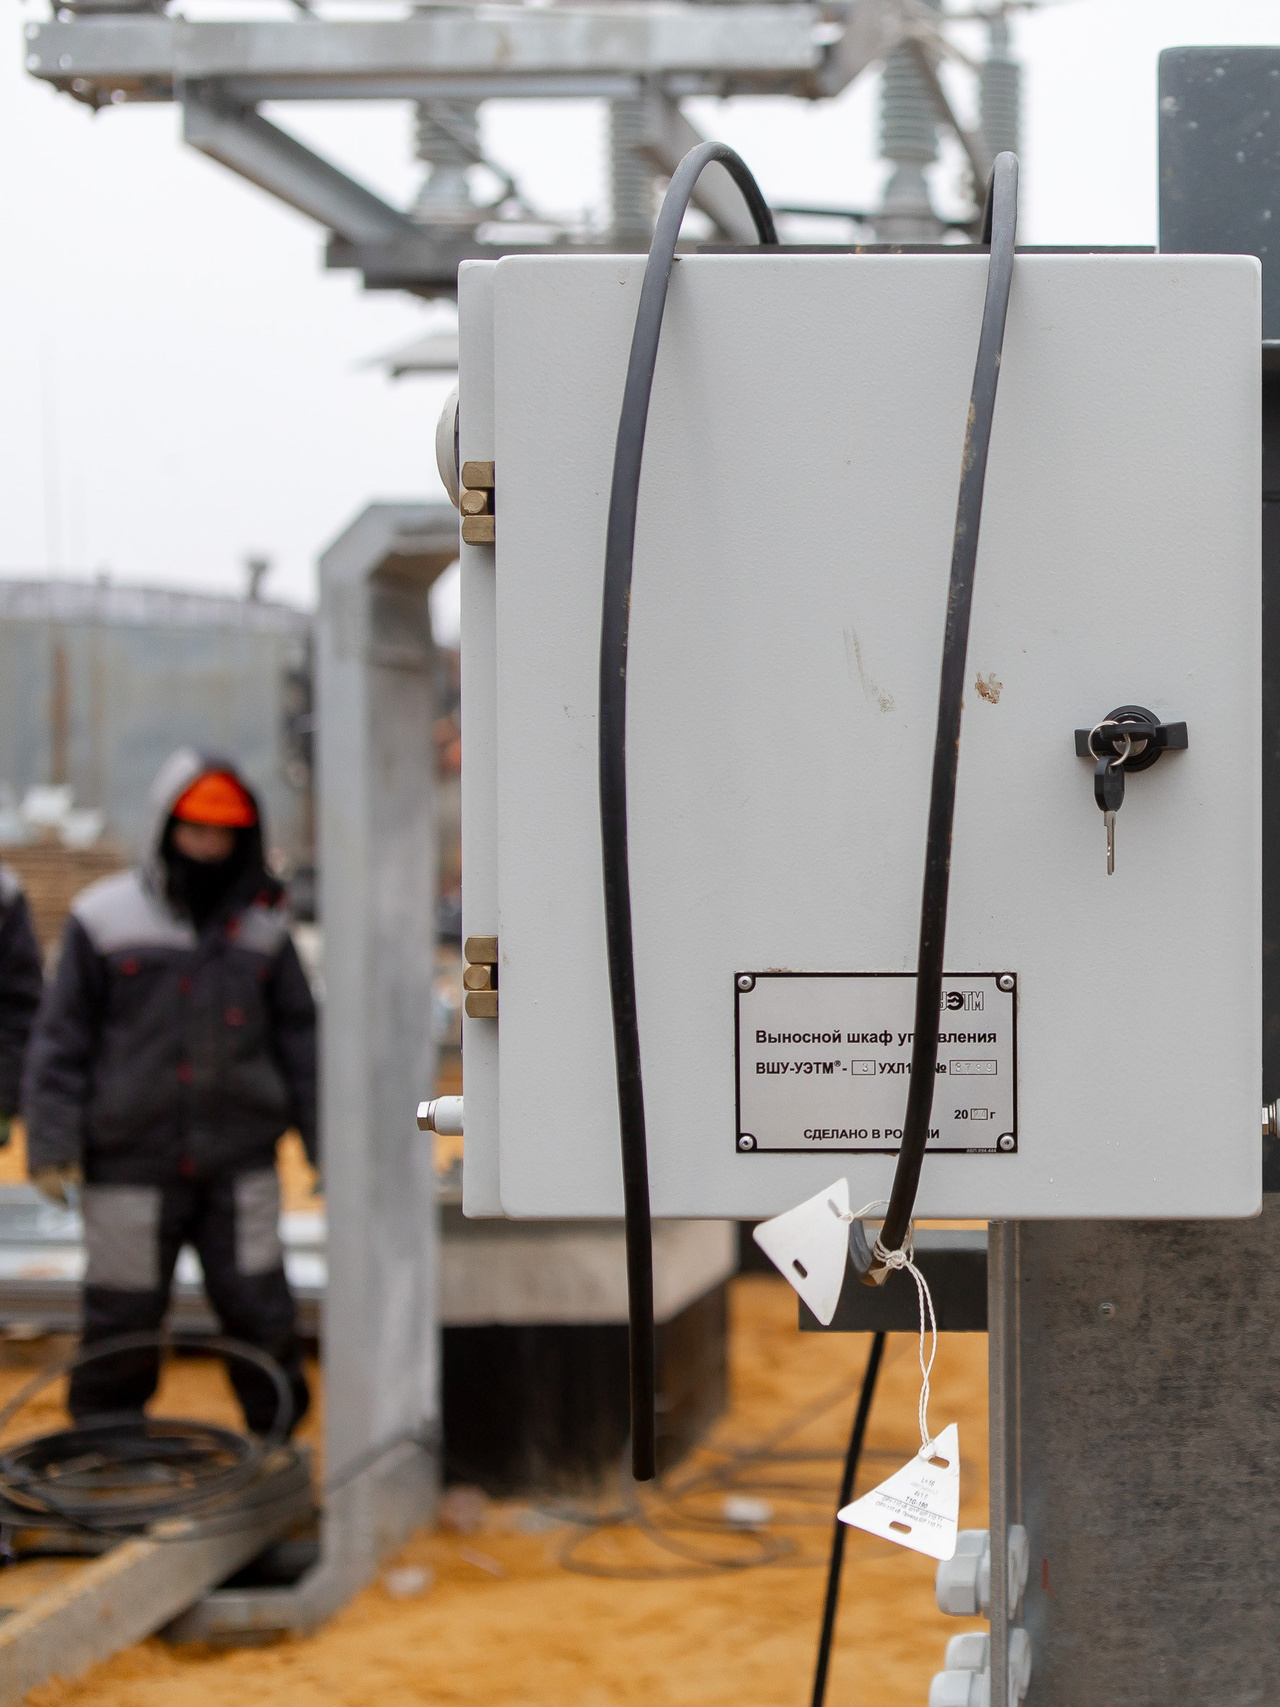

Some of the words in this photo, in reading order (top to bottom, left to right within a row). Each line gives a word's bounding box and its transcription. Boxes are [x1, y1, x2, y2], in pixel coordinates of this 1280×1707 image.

[756, 1030, 841, 1044] Выносной
[847, 1030, 893, 1046] шкаф
[898, 1032, 997, 1046] упвления
[878, 1062, 912, 1074] УХЛ1
[804, 1128, 868, 1140] СДЕЛАНО
[872, 1129, 881, 1139] В
